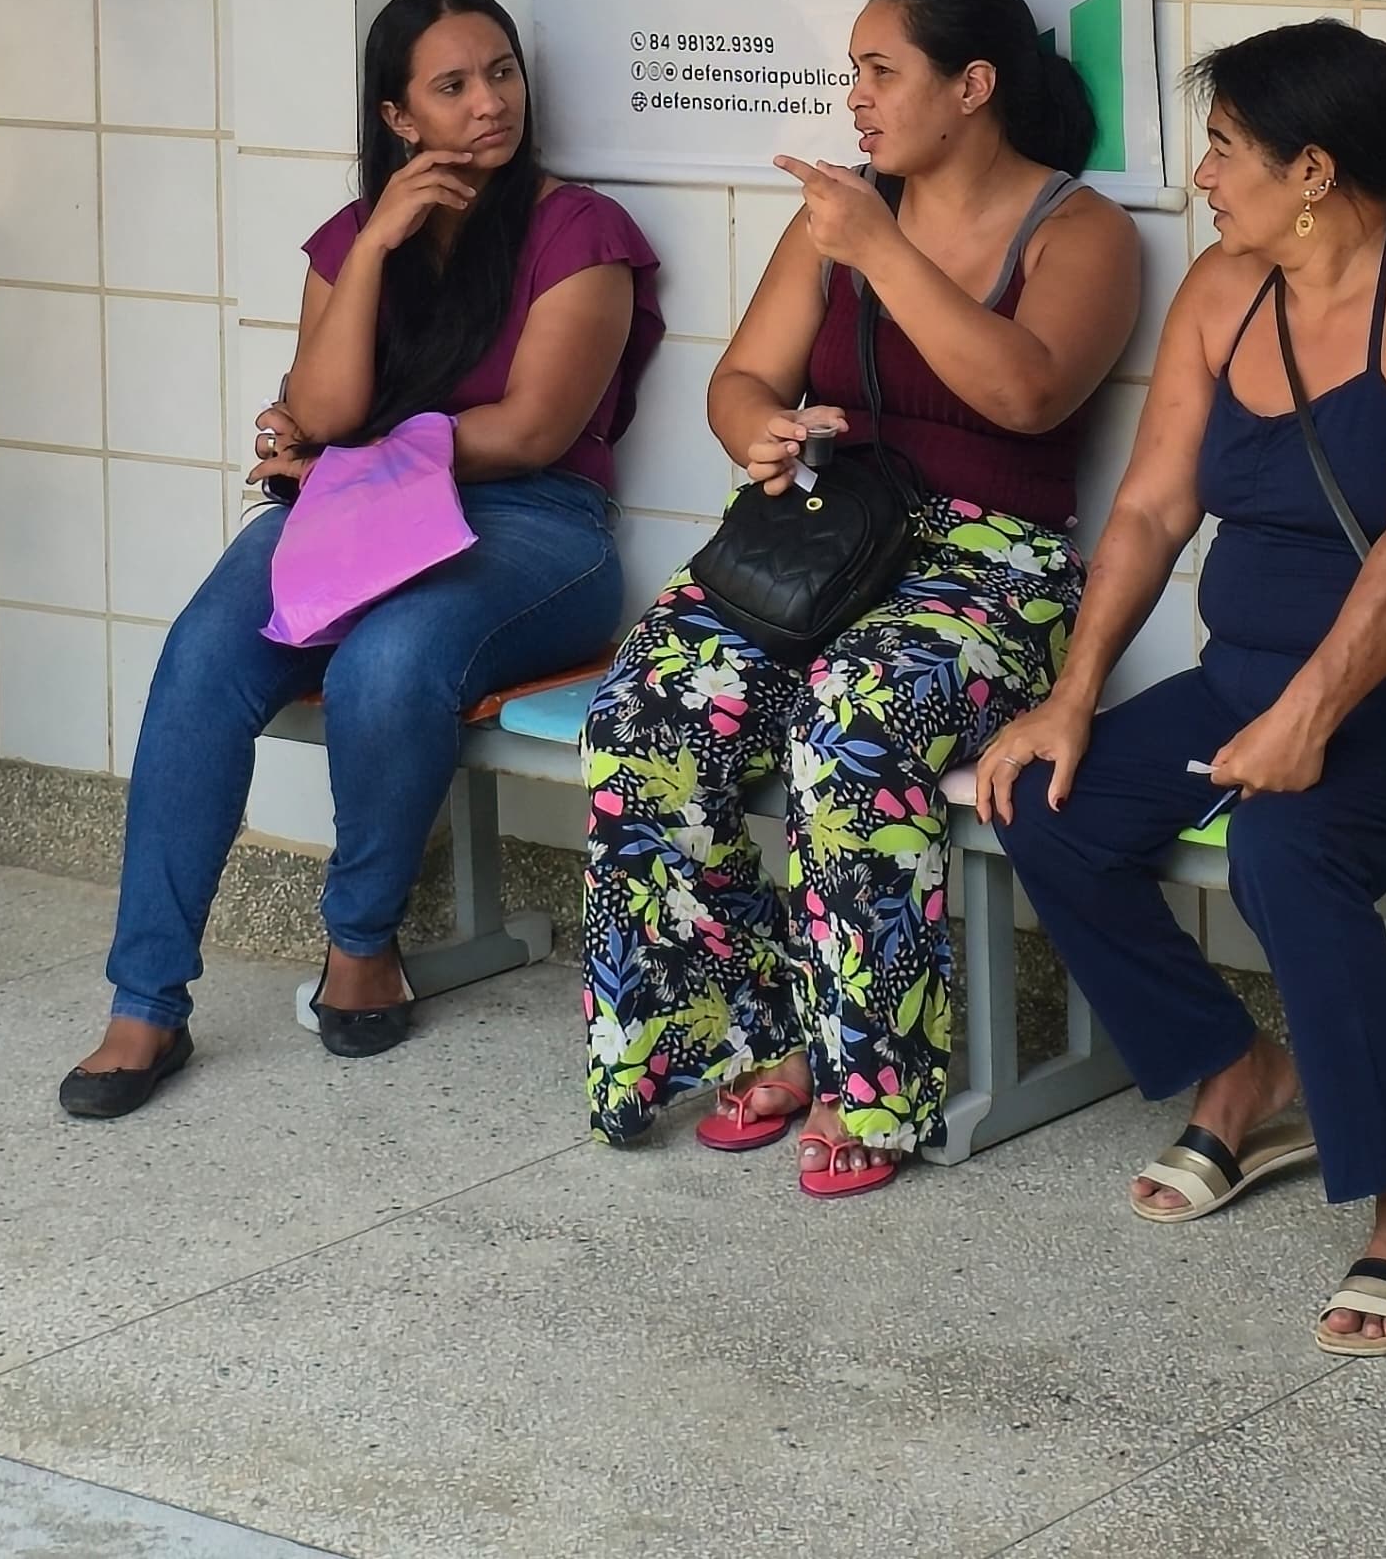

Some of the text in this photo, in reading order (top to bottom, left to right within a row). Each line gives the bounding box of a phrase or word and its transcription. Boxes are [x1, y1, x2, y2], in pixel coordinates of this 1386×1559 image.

[649, 33, 774, 53] 84 98132.9399
[651, 92, 832, 115] defensoria.rn.def.br
